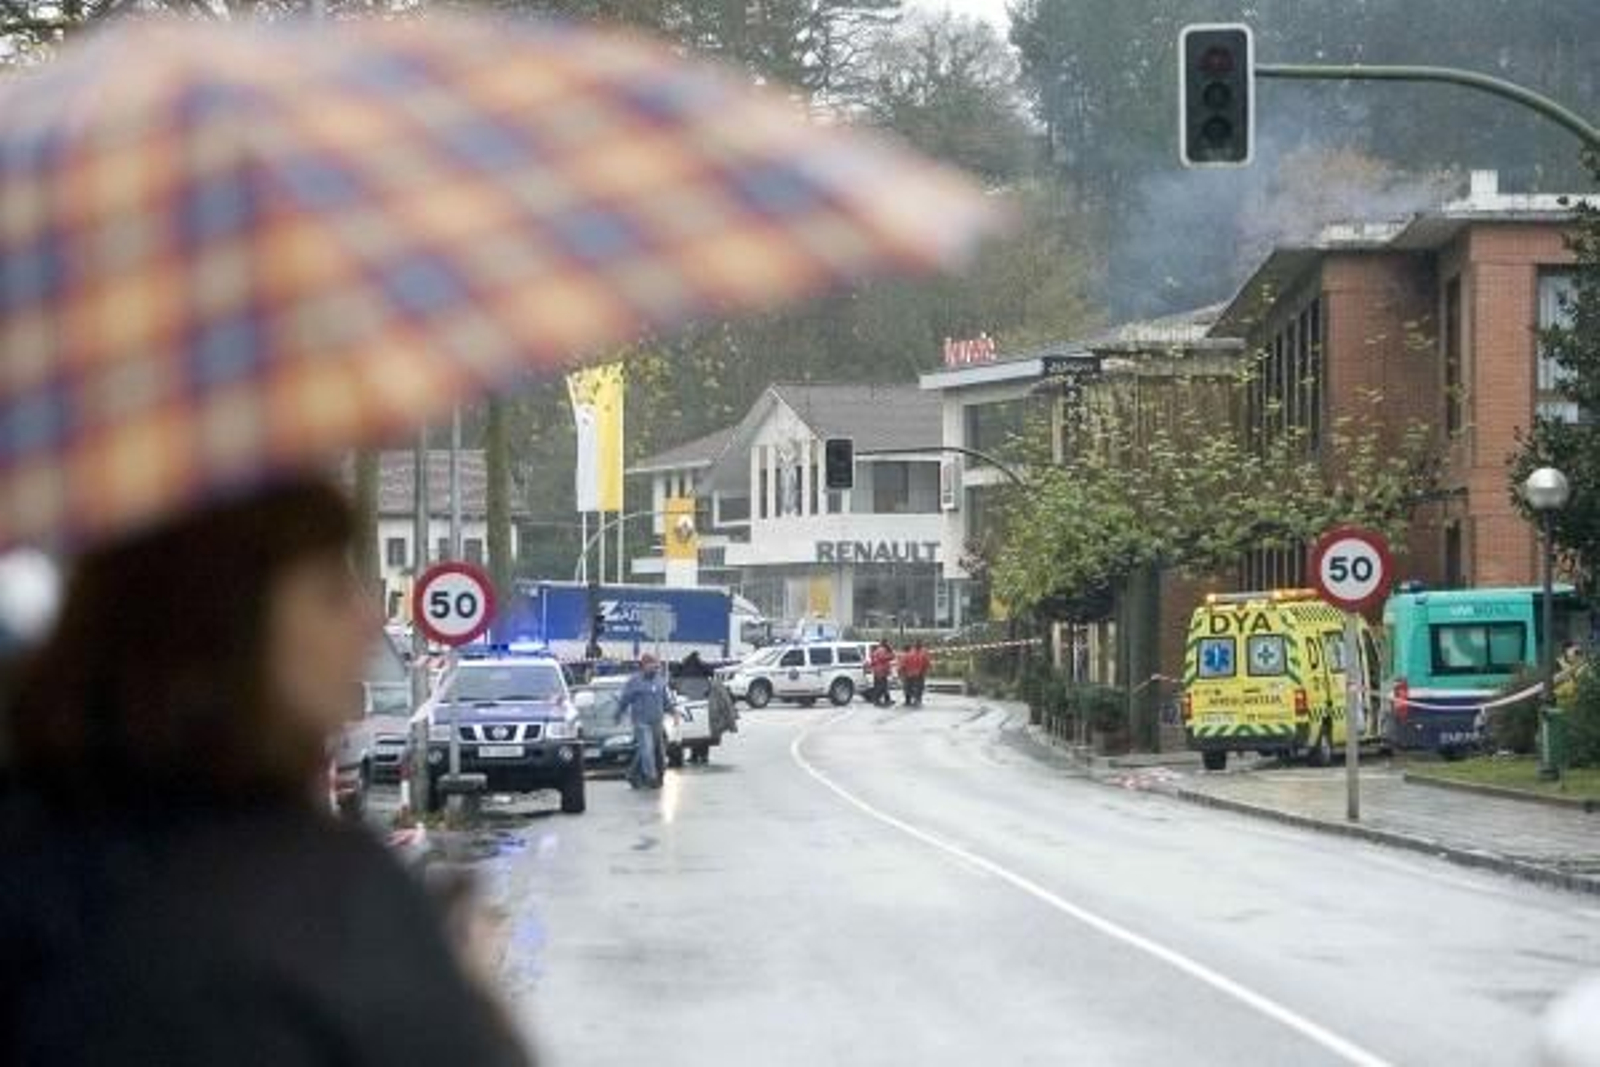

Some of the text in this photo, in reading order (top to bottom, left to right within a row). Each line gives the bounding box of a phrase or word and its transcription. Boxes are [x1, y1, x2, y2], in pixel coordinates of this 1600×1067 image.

[816, 540, 941, 564] RENAULT
[1329, 556, 1374, 584] 50
[429, 590, 478, 619] 50
[1209, 611, 1273, 635] DYA
